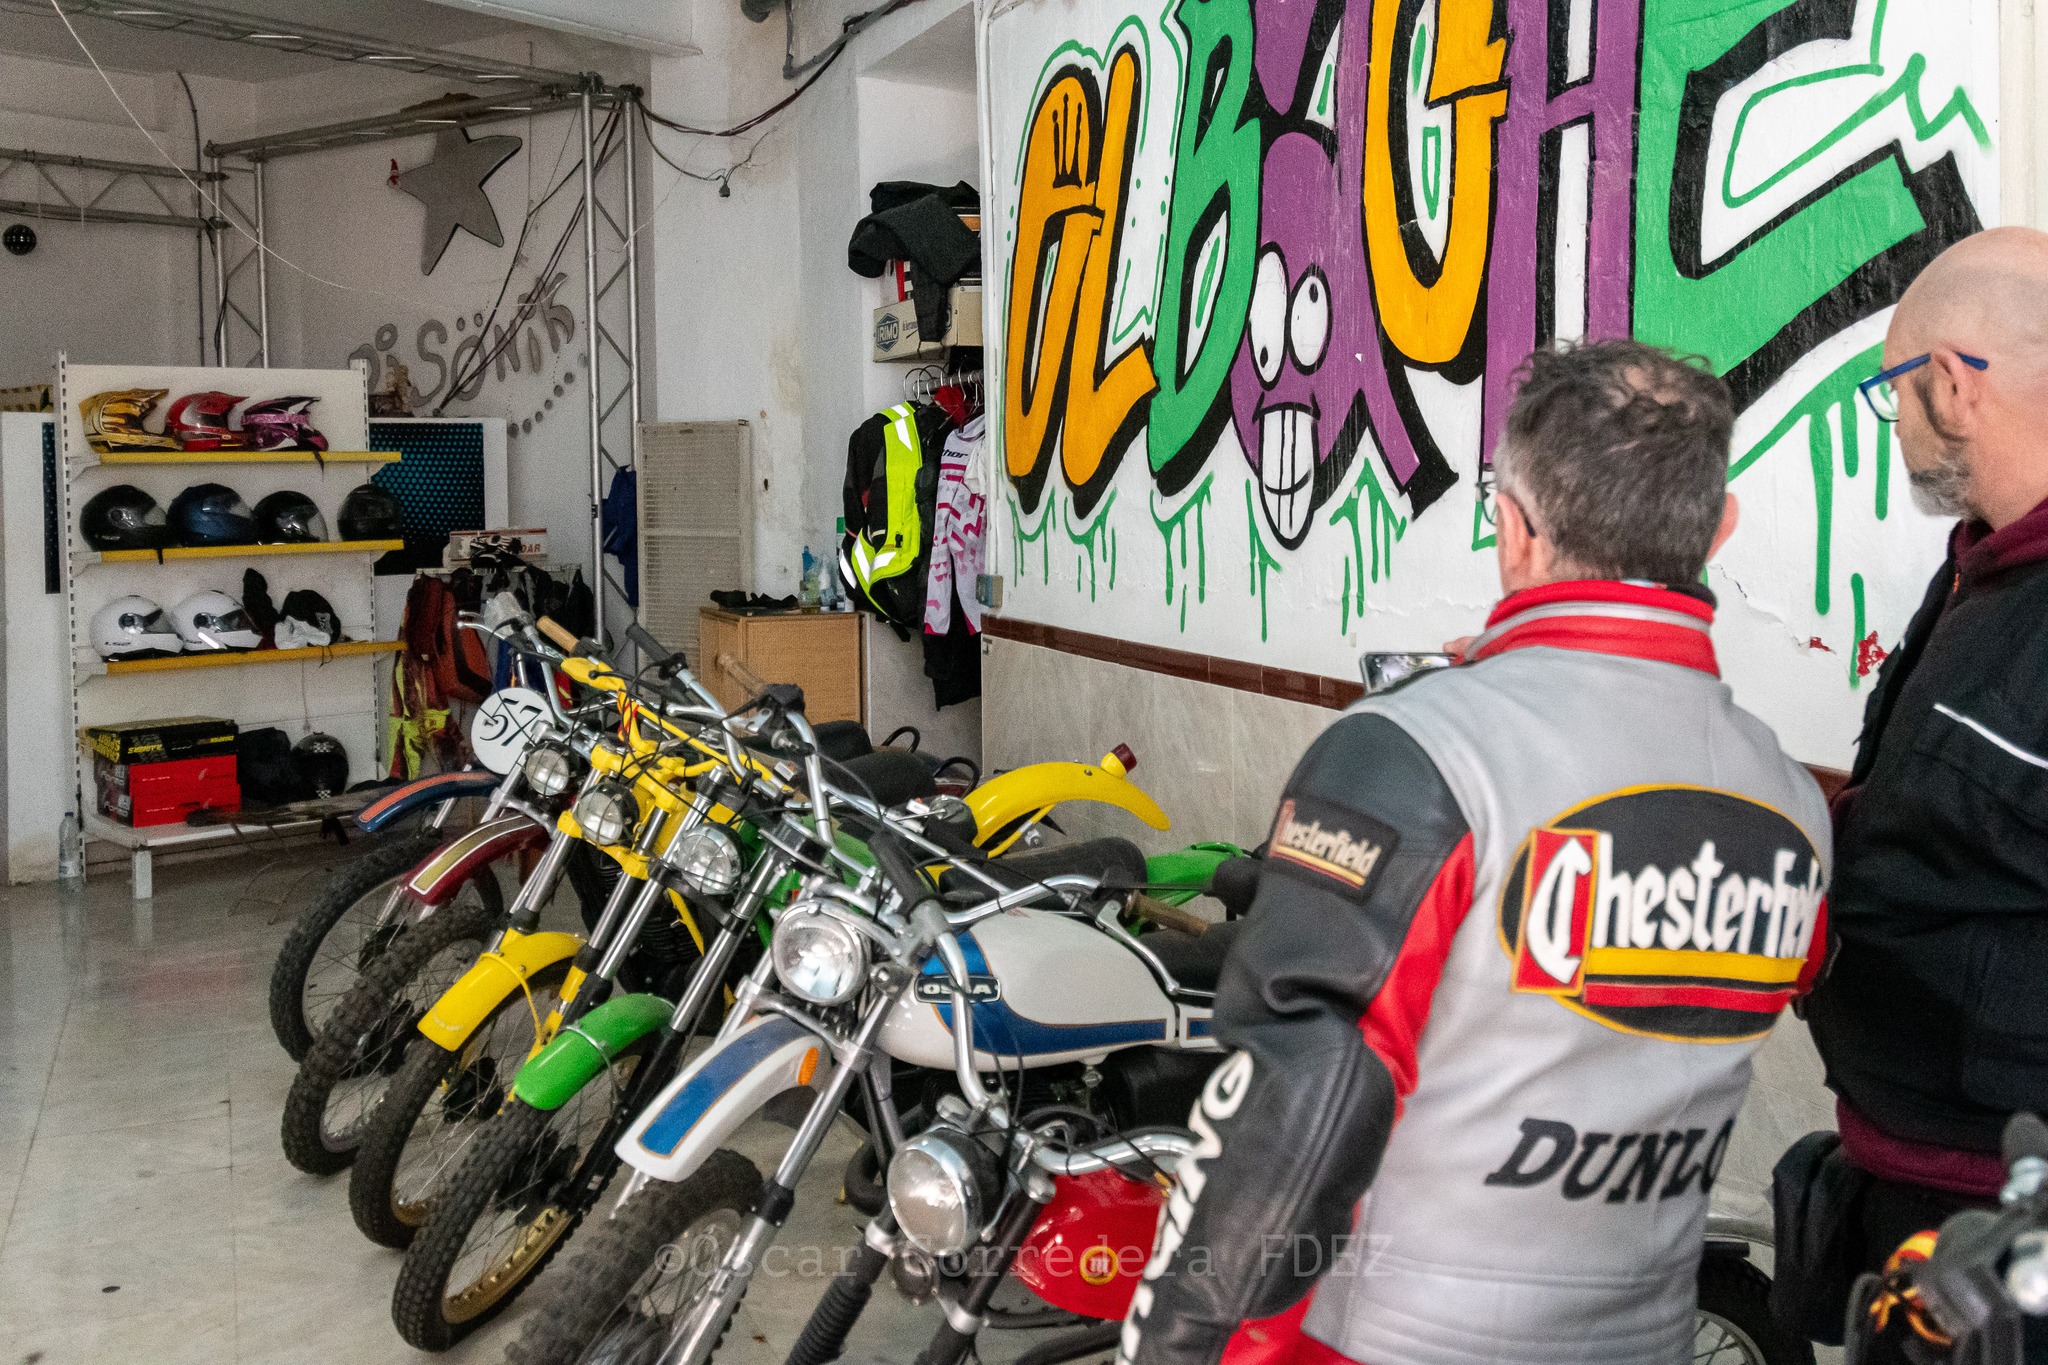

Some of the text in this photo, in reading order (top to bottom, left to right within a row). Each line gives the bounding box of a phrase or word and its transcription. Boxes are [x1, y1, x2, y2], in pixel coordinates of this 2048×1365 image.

[479, 697, 544, 747] 57
[923, 983, 992, 995] OSA
[1483, 1116, 1735, 1204] DUNLO
